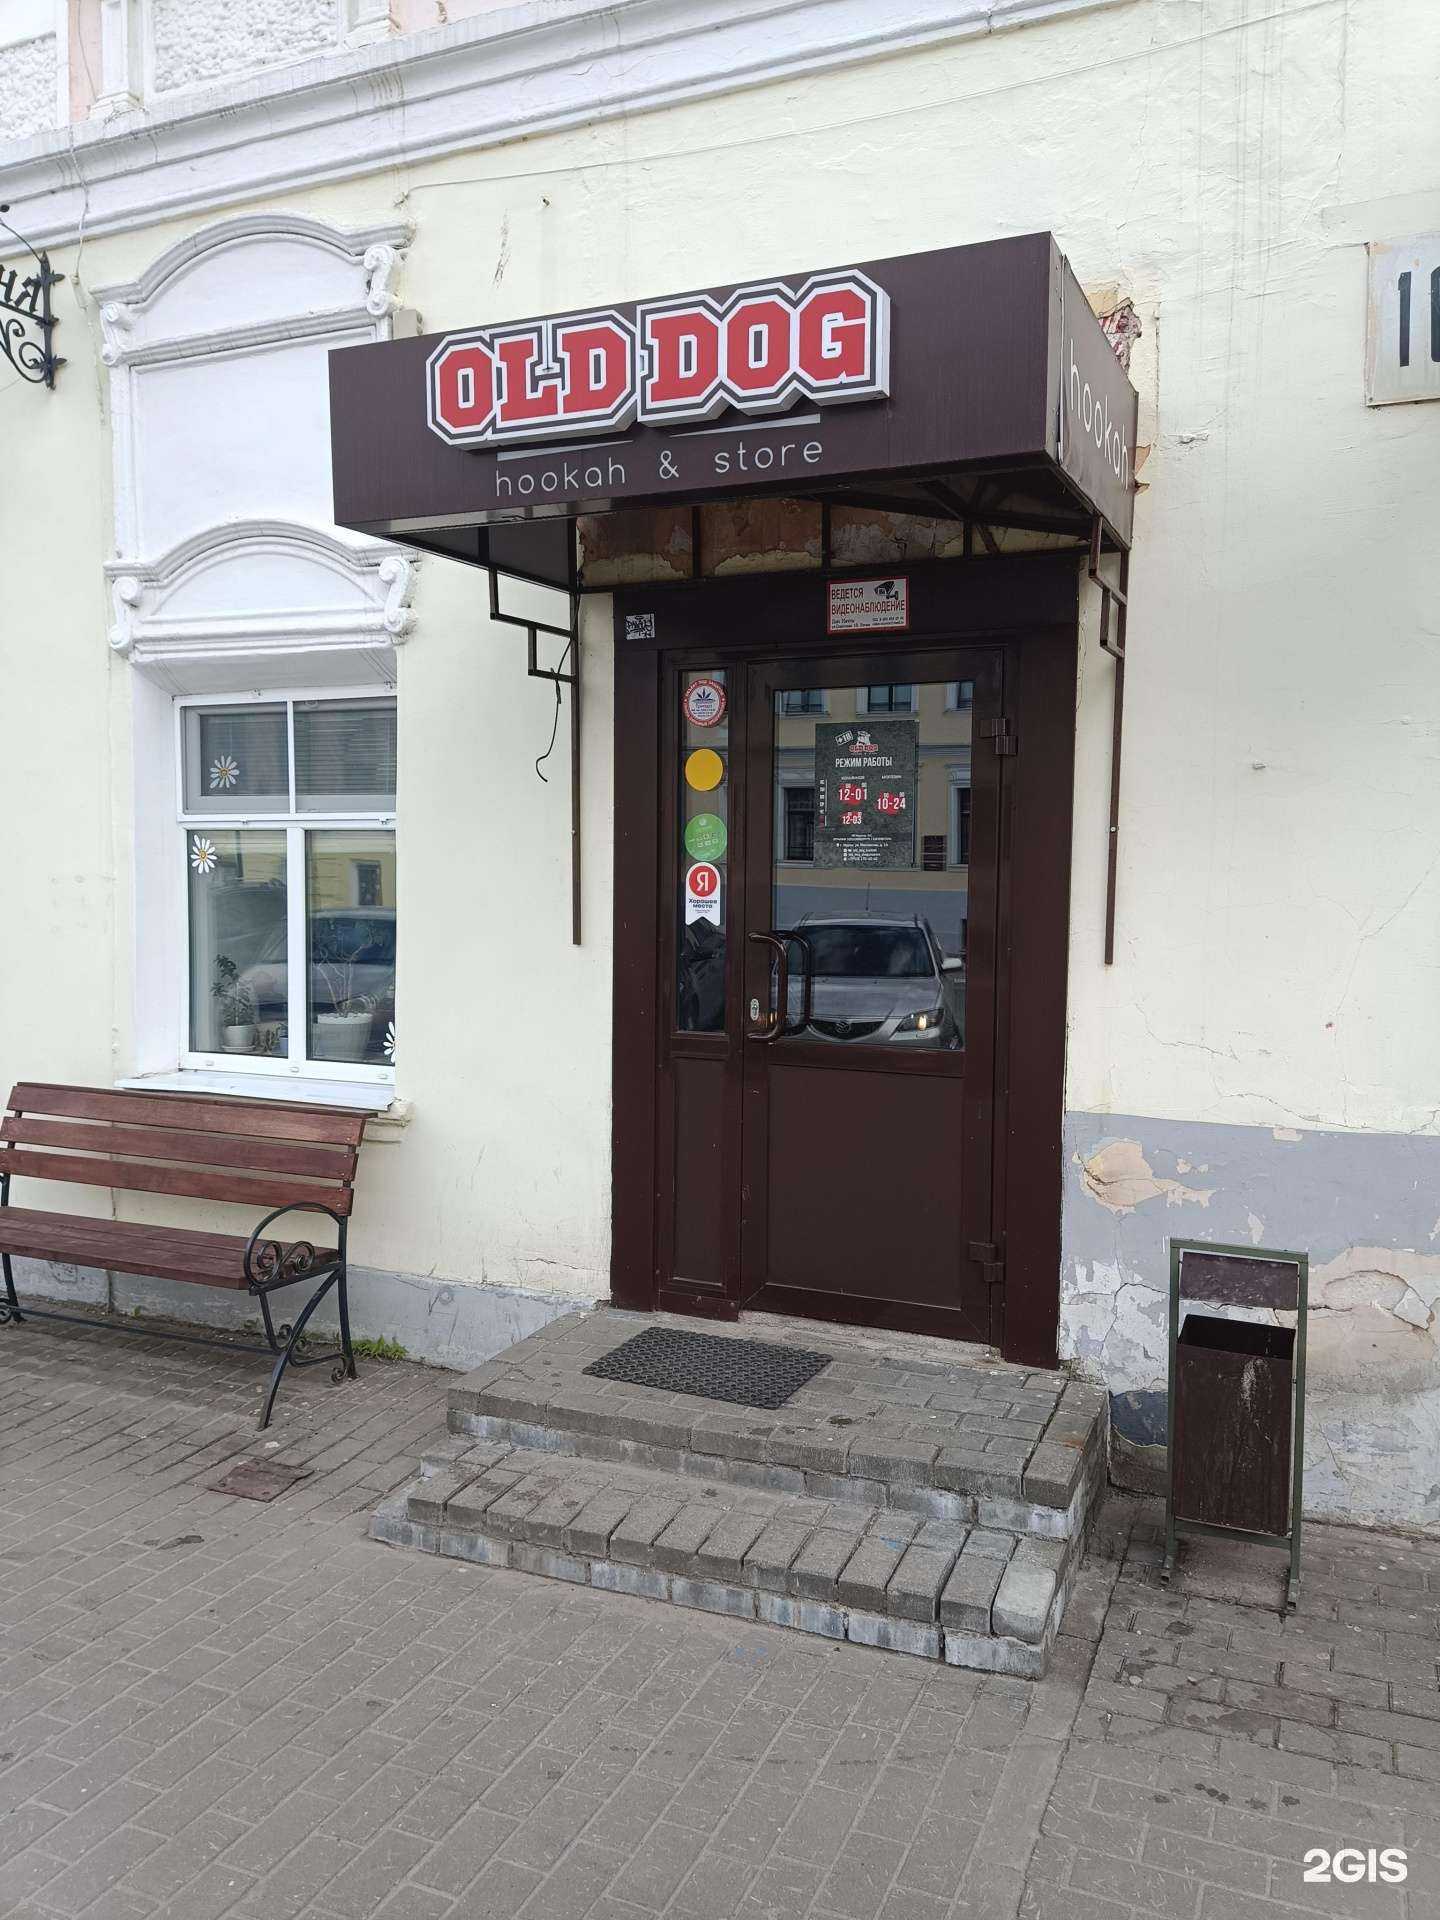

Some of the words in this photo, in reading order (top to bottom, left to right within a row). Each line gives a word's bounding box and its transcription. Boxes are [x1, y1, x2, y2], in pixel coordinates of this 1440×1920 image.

[427, 309, 637, 450] OLD
[637, 269, 890, 422] DOG
[1068, 338, 1130, 494] hookah
[494, 457, 626, 497] hookah
[658, 450, 680, 480] &
[714, 440, 824, 474] store
[831, 587, 864, 601] ВЕДЕТСЯ
[831, 600, 906, 616] ВИДЕОНАБЛЮДЕНИЕ
[835, 757, 862, 768] РЕЖИМ
[863, 756, 893, 767] РАБОТЫ
[696, 871, 709, 892] Я
